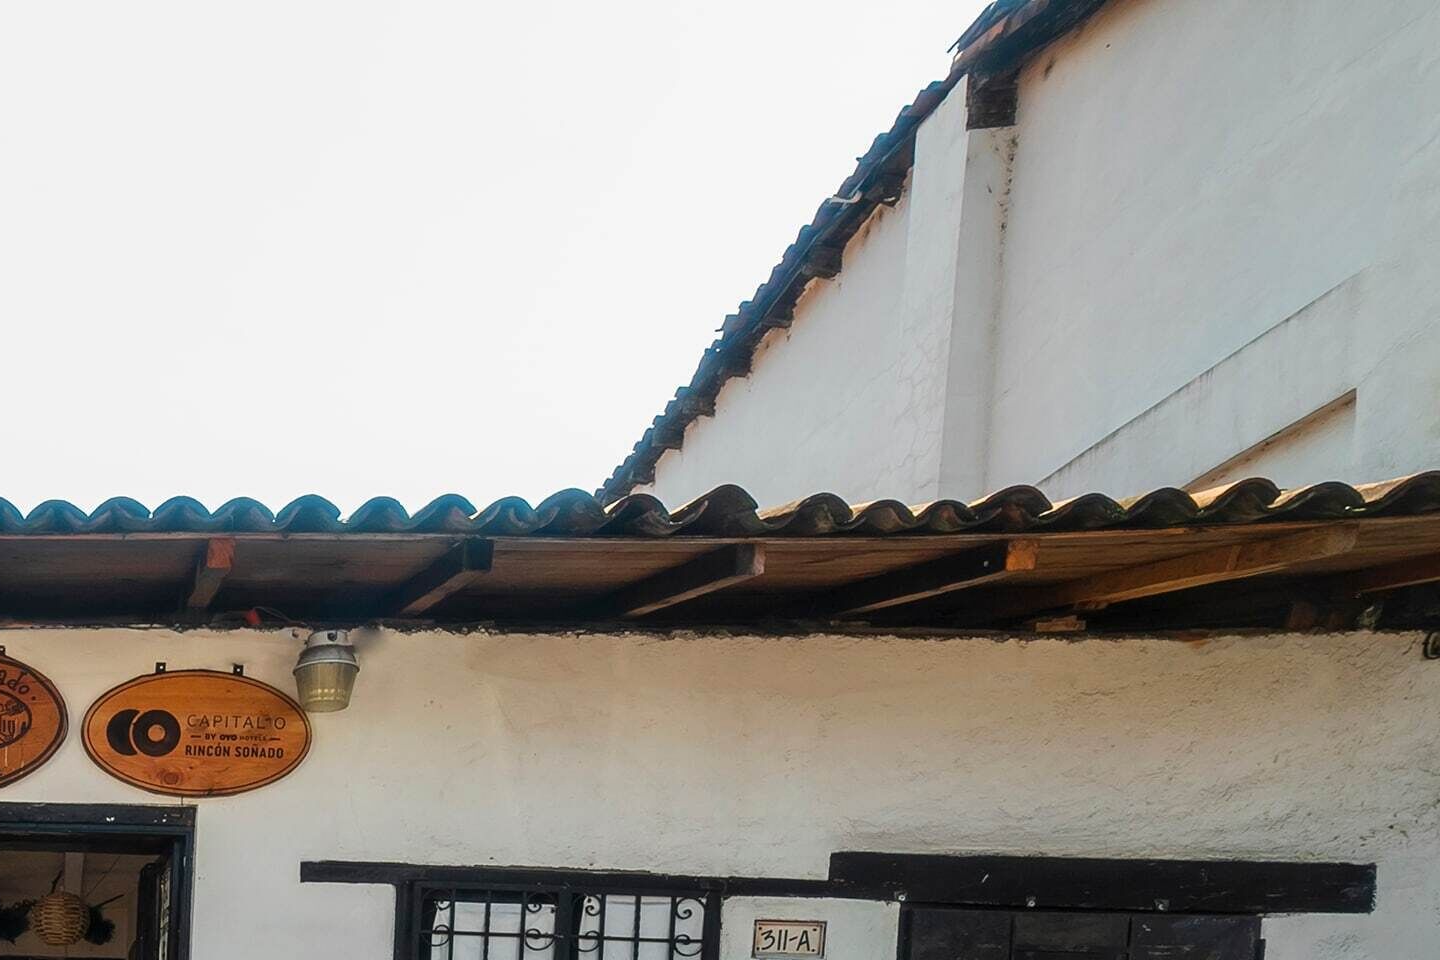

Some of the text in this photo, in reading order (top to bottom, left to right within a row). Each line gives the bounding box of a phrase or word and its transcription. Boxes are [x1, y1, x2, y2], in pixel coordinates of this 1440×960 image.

[187, 714, 286, 730] CAPITAL O
[219, 733, 237, 741] OYO
[185, 743, 284, 759] RINCÓN SOÑADO
[761, 929, 811, 951] 311-A
